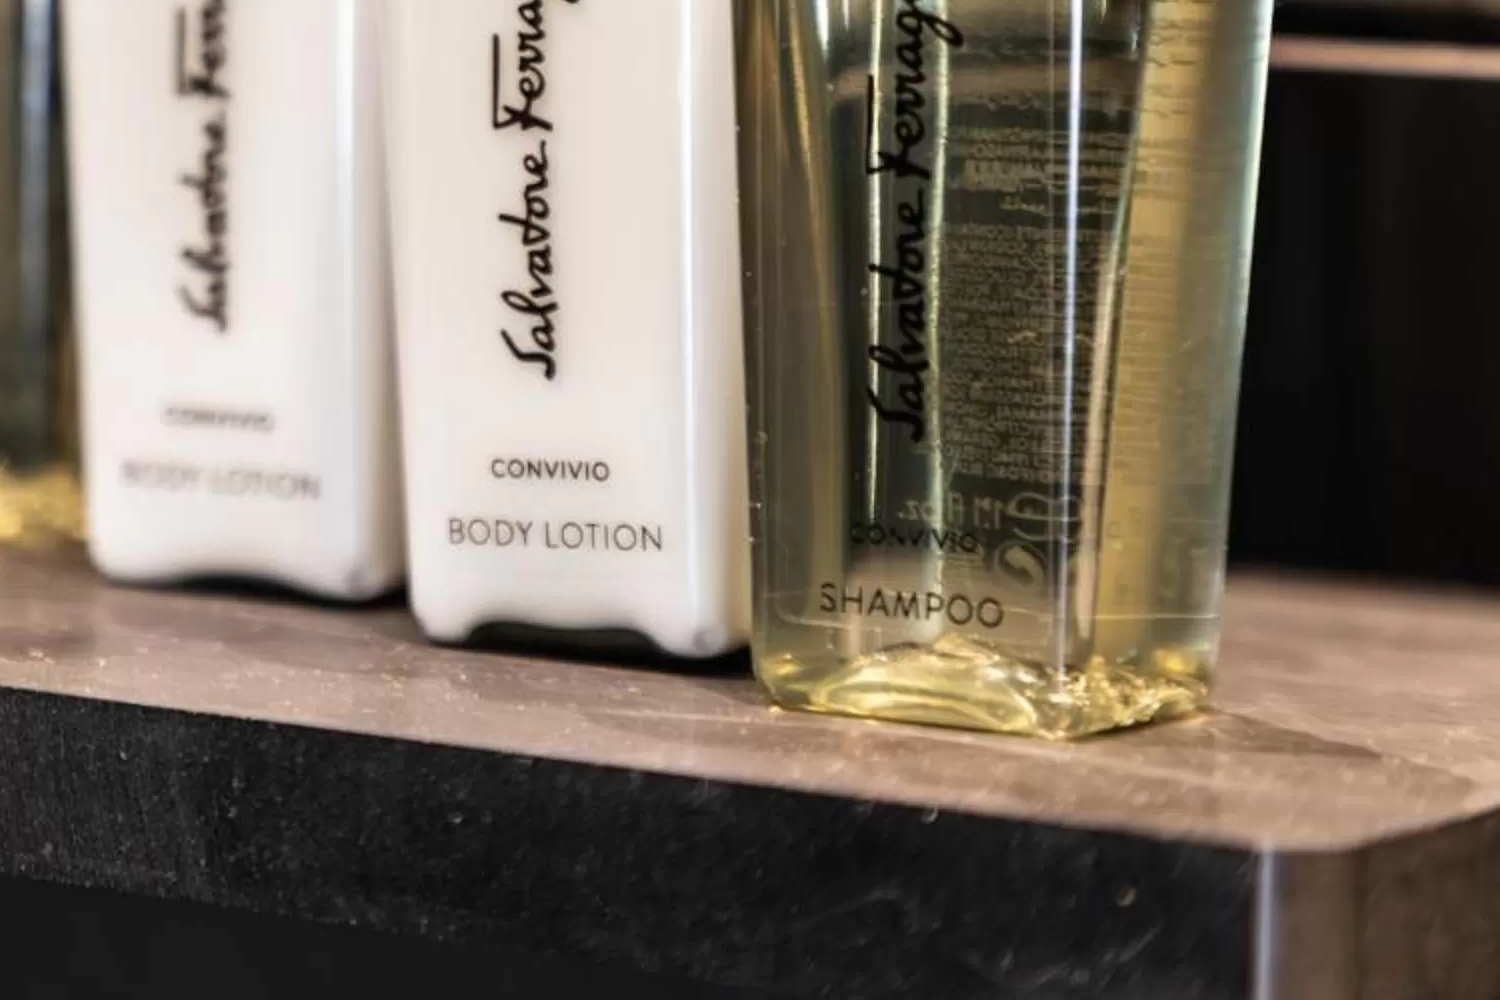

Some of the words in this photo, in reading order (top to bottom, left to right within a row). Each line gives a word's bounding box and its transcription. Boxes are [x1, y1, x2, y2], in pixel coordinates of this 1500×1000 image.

[497, 139, 559, 382] Salvatore
[865, 187, 931, 443] Salvatore
[490, 457, 611, 483] CONVIVIO
[447, 517, 534, 548] BODY
[545, 521, 663, 552] LOTION
[819, 583, 1004, 628] SHAMPOO
